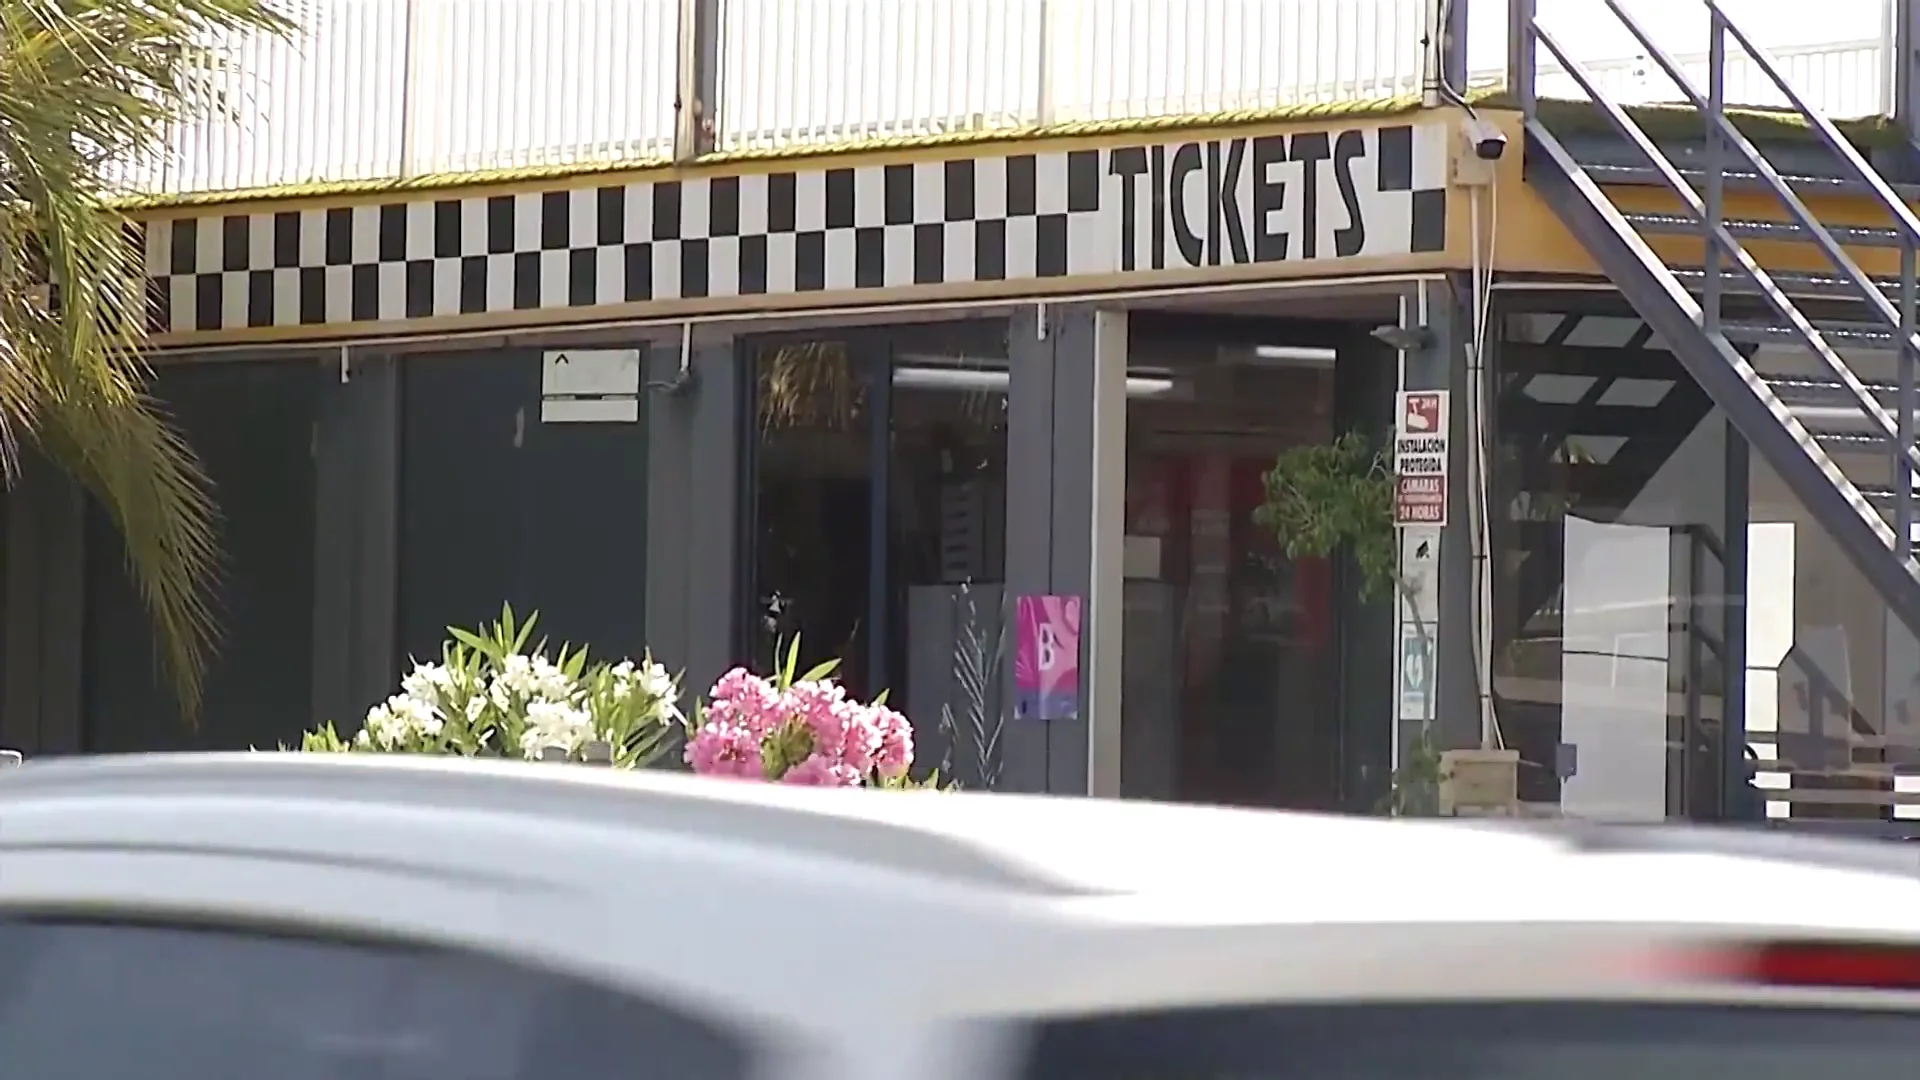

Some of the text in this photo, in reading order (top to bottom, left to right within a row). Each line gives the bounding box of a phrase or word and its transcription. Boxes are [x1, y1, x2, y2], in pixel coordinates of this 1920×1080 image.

[1108, 130, 1366, 271] TICKETS
[1400, 458, 1442, 472] PROTEGIDA
[1400, 504, 1440, 519] 24 HORAS
